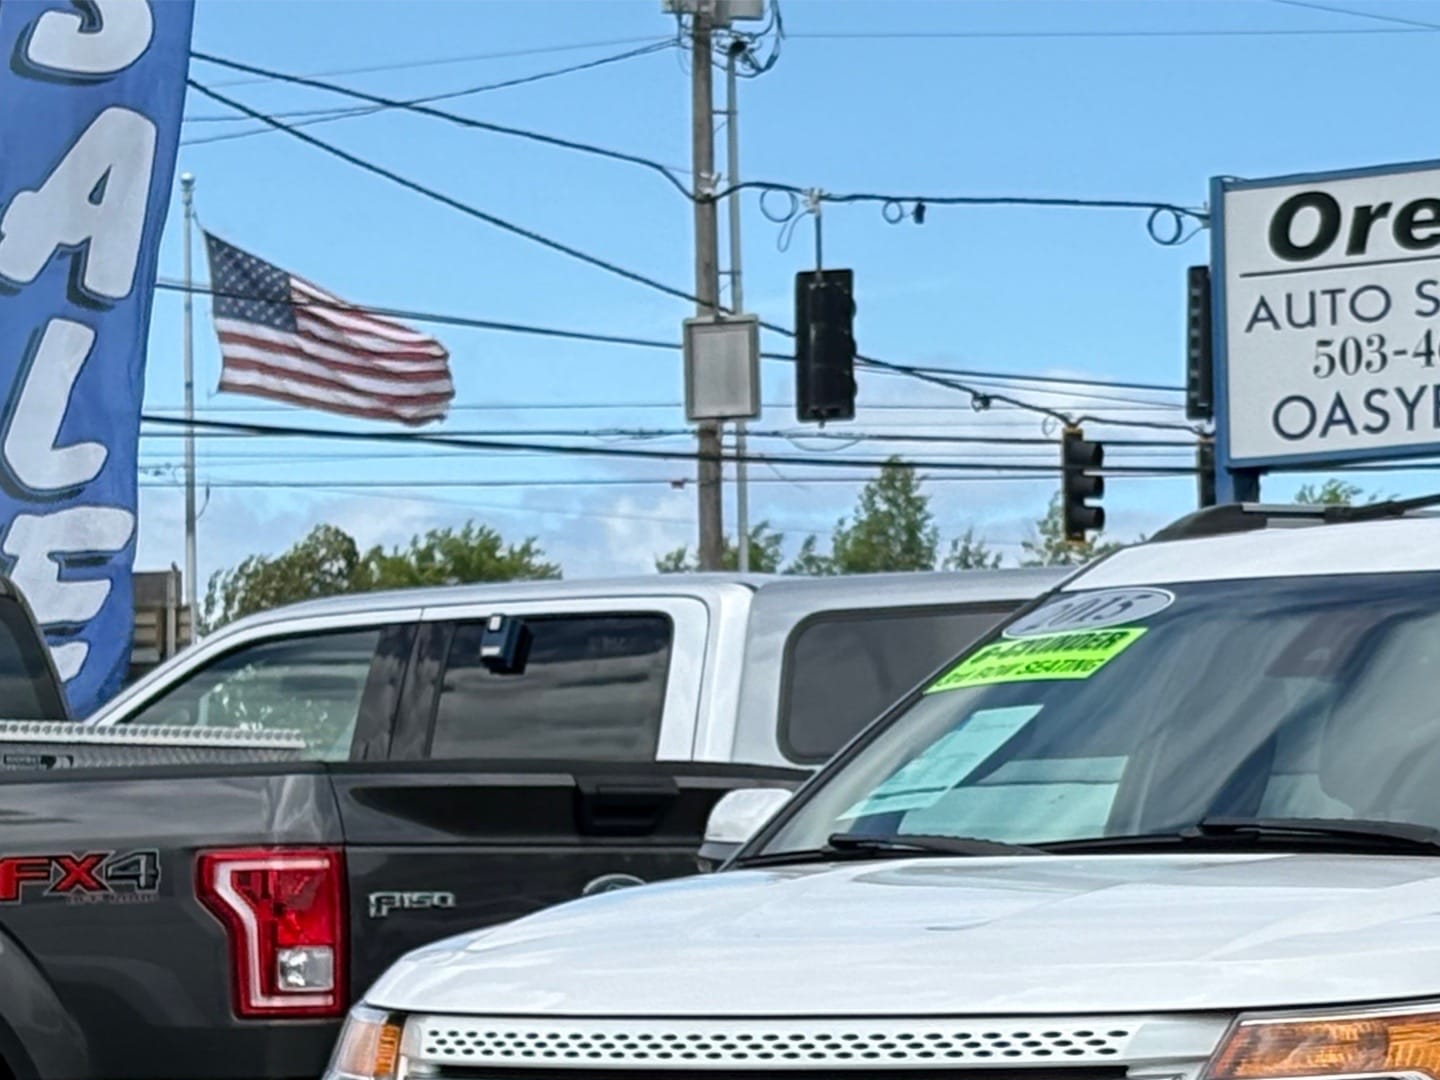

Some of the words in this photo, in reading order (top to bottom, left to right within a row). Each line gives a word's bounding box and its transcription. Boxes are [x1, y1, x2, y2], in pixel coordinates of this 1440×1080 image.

[1243, 283, 1392, 333] AUTO
[1020, 593, 1153, 633] 2015
[1015, 658, 1106, 675] SEATING
[0, 848, 160, 905] FX4
